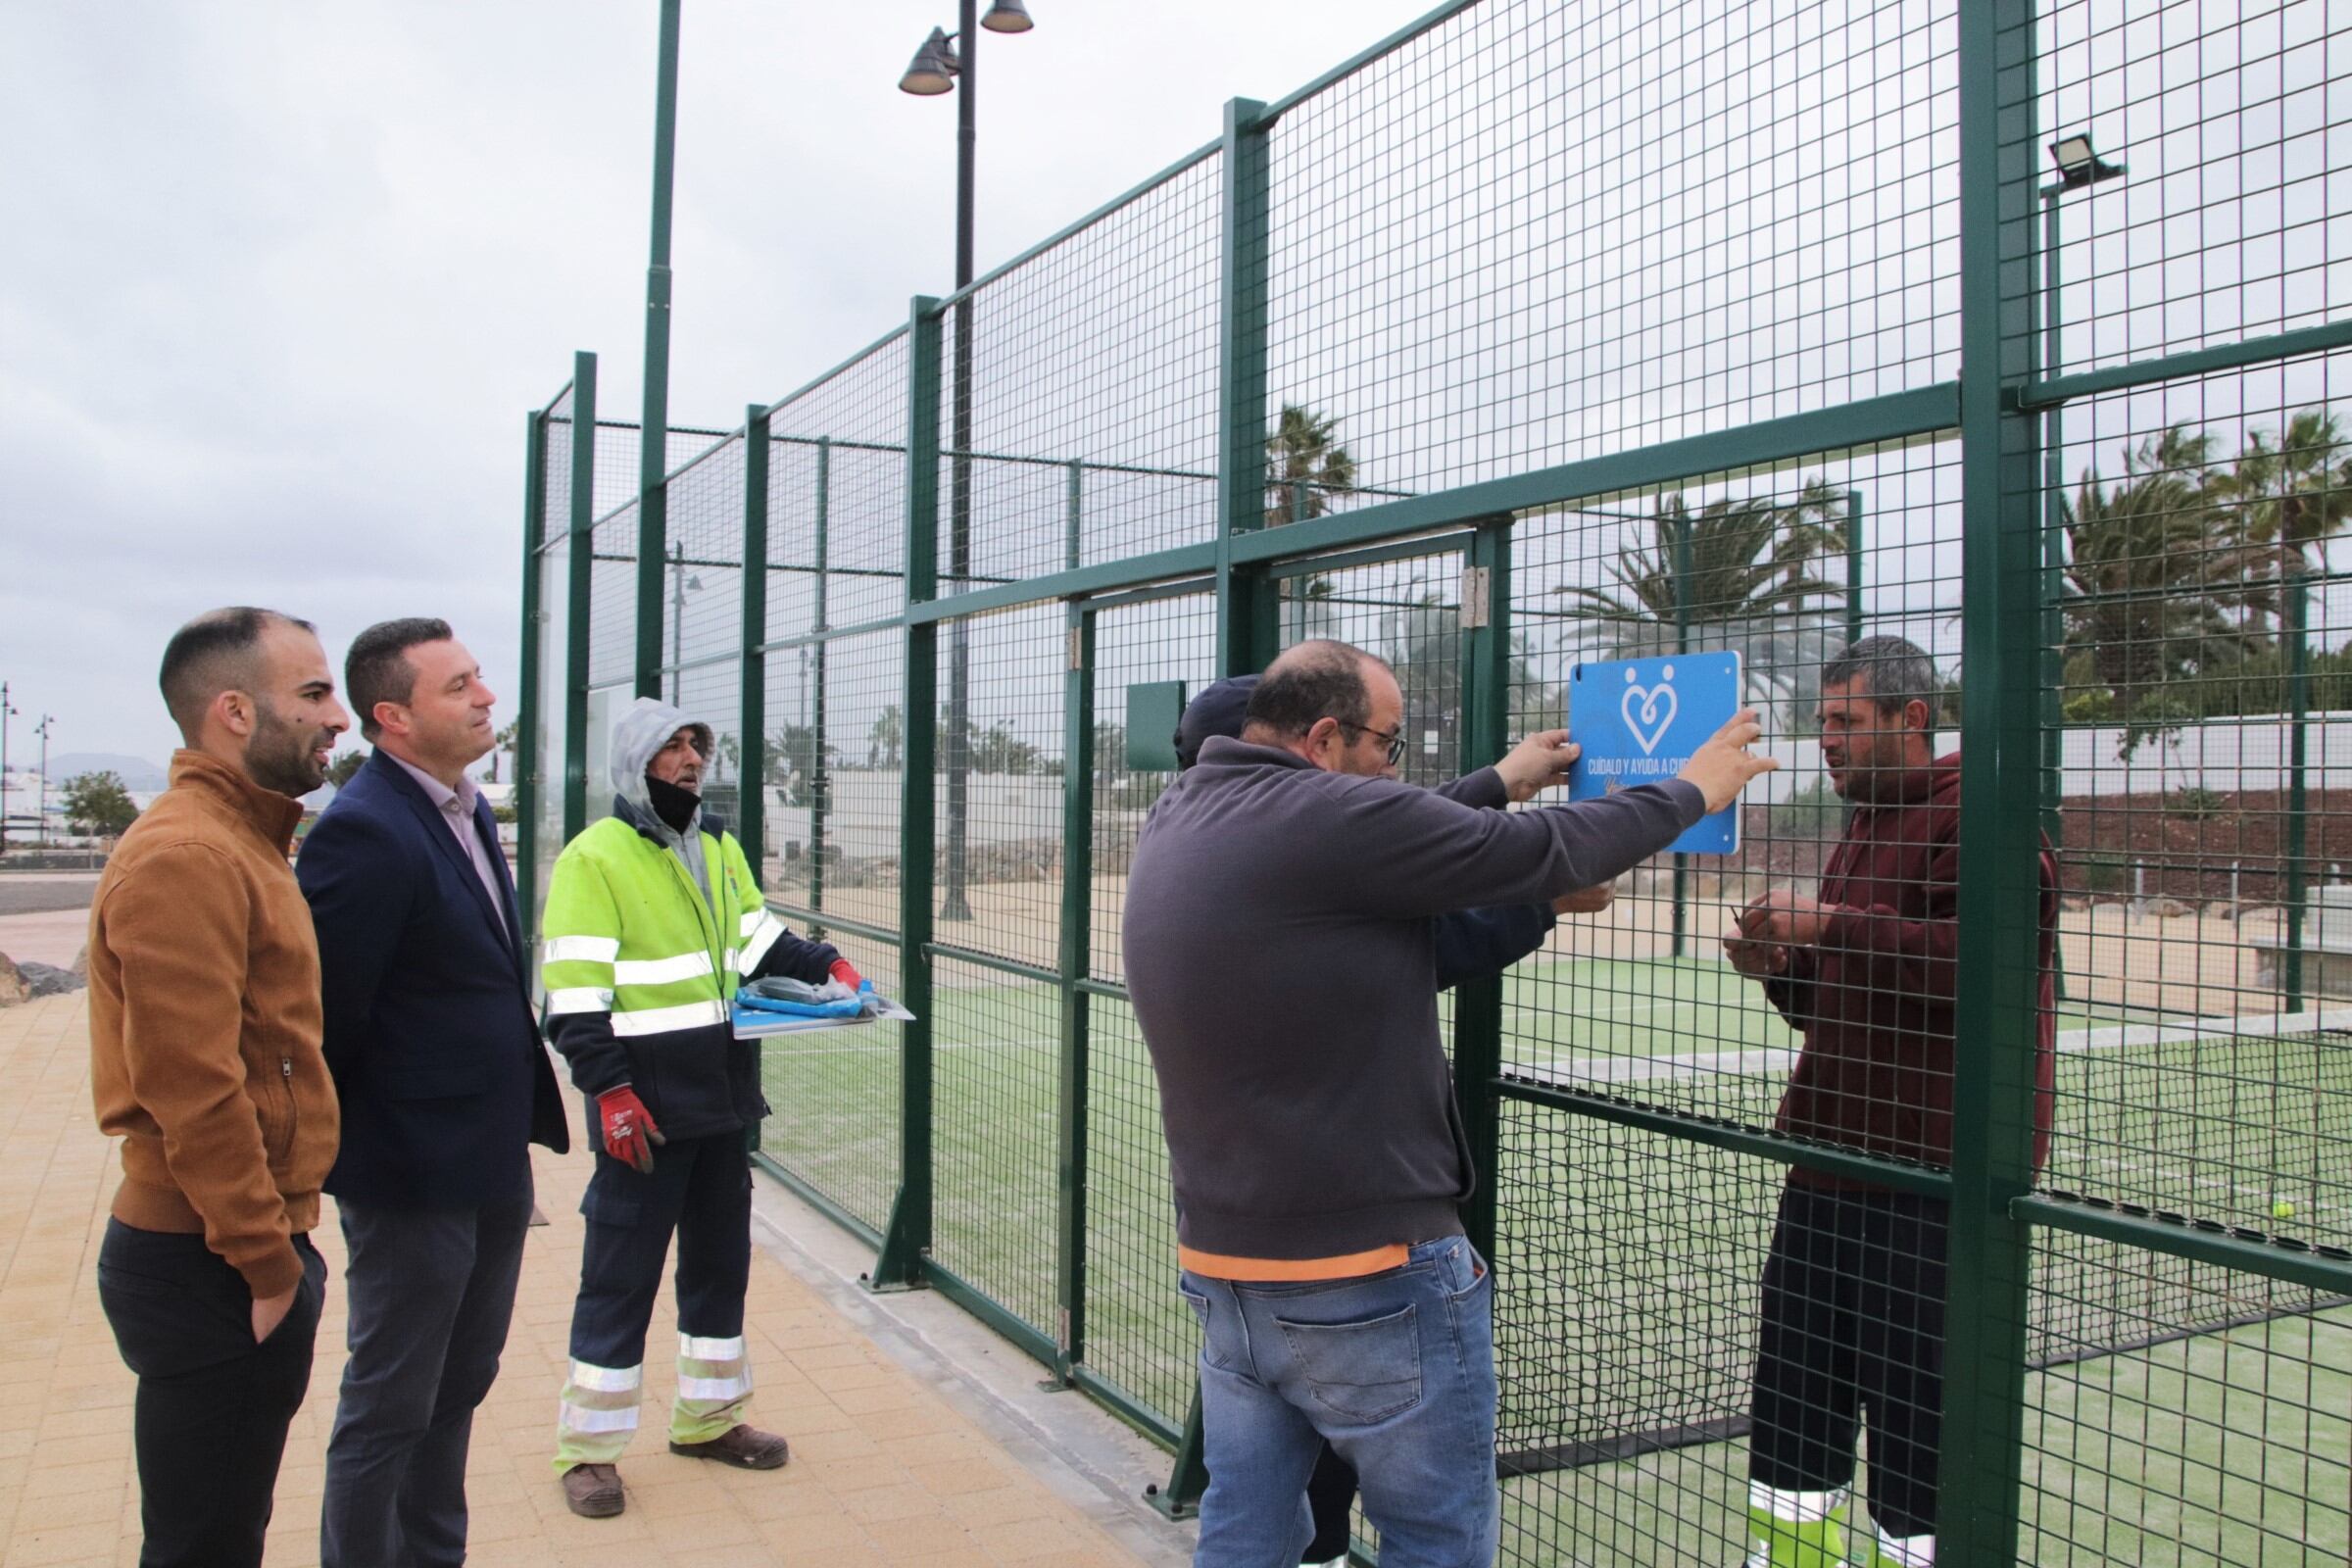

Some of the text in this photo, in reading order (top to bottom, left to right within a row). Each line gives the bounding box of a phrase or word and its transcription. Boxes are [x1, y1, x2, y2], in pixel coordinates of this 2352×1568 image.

[1588, 756, 1622, 775] CUÍDALO
[1622, 758, 1630, 775] Y
[1630, 758, 1660, 775] AYUDA
[1660, 758, 1669, 775] A
